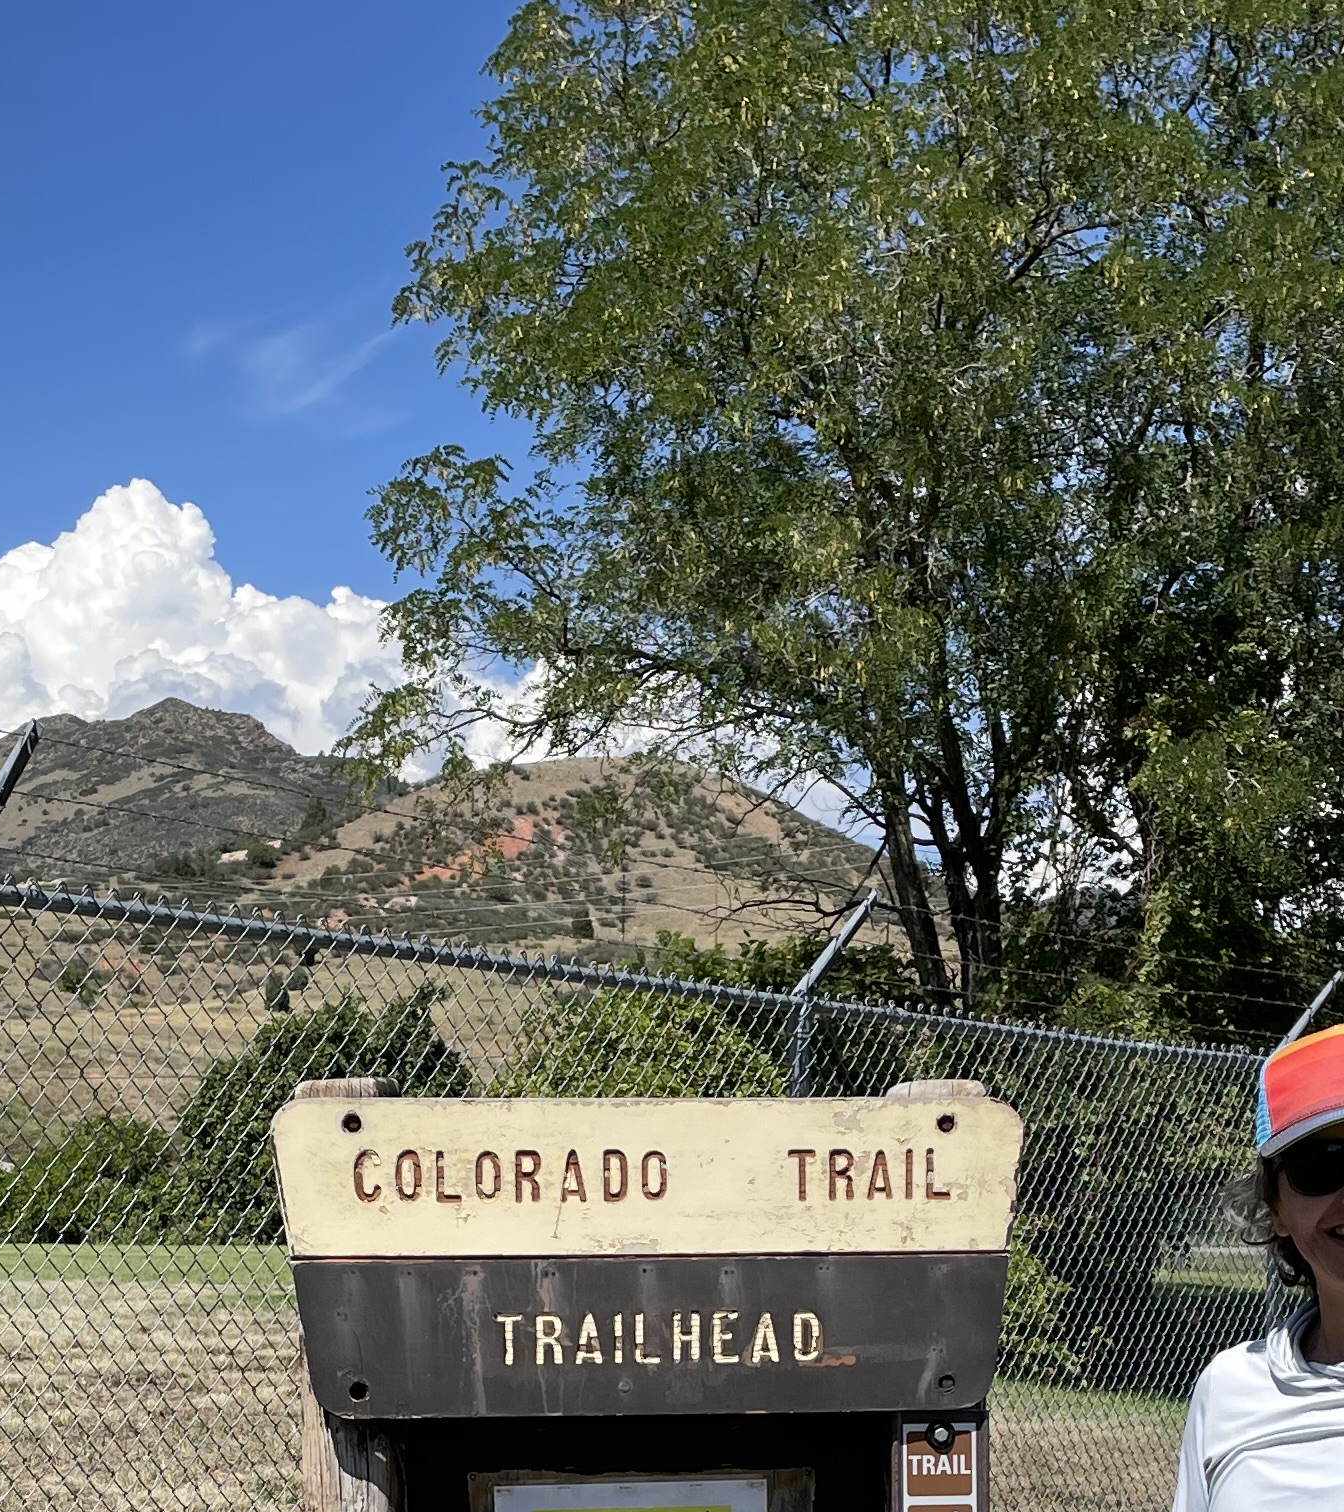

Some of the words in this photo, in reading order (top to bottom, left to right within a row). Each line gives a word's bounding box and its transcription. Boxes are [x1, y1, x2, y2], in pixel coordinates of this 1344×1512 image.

[353, 1148, 670, 1204] COLORADO
[787, 1147, 952, 1201] TRAIL
[493, 1310, 823, 1366] TRAILHEAD
[908, 1454, 971, 1475] TRAIL
